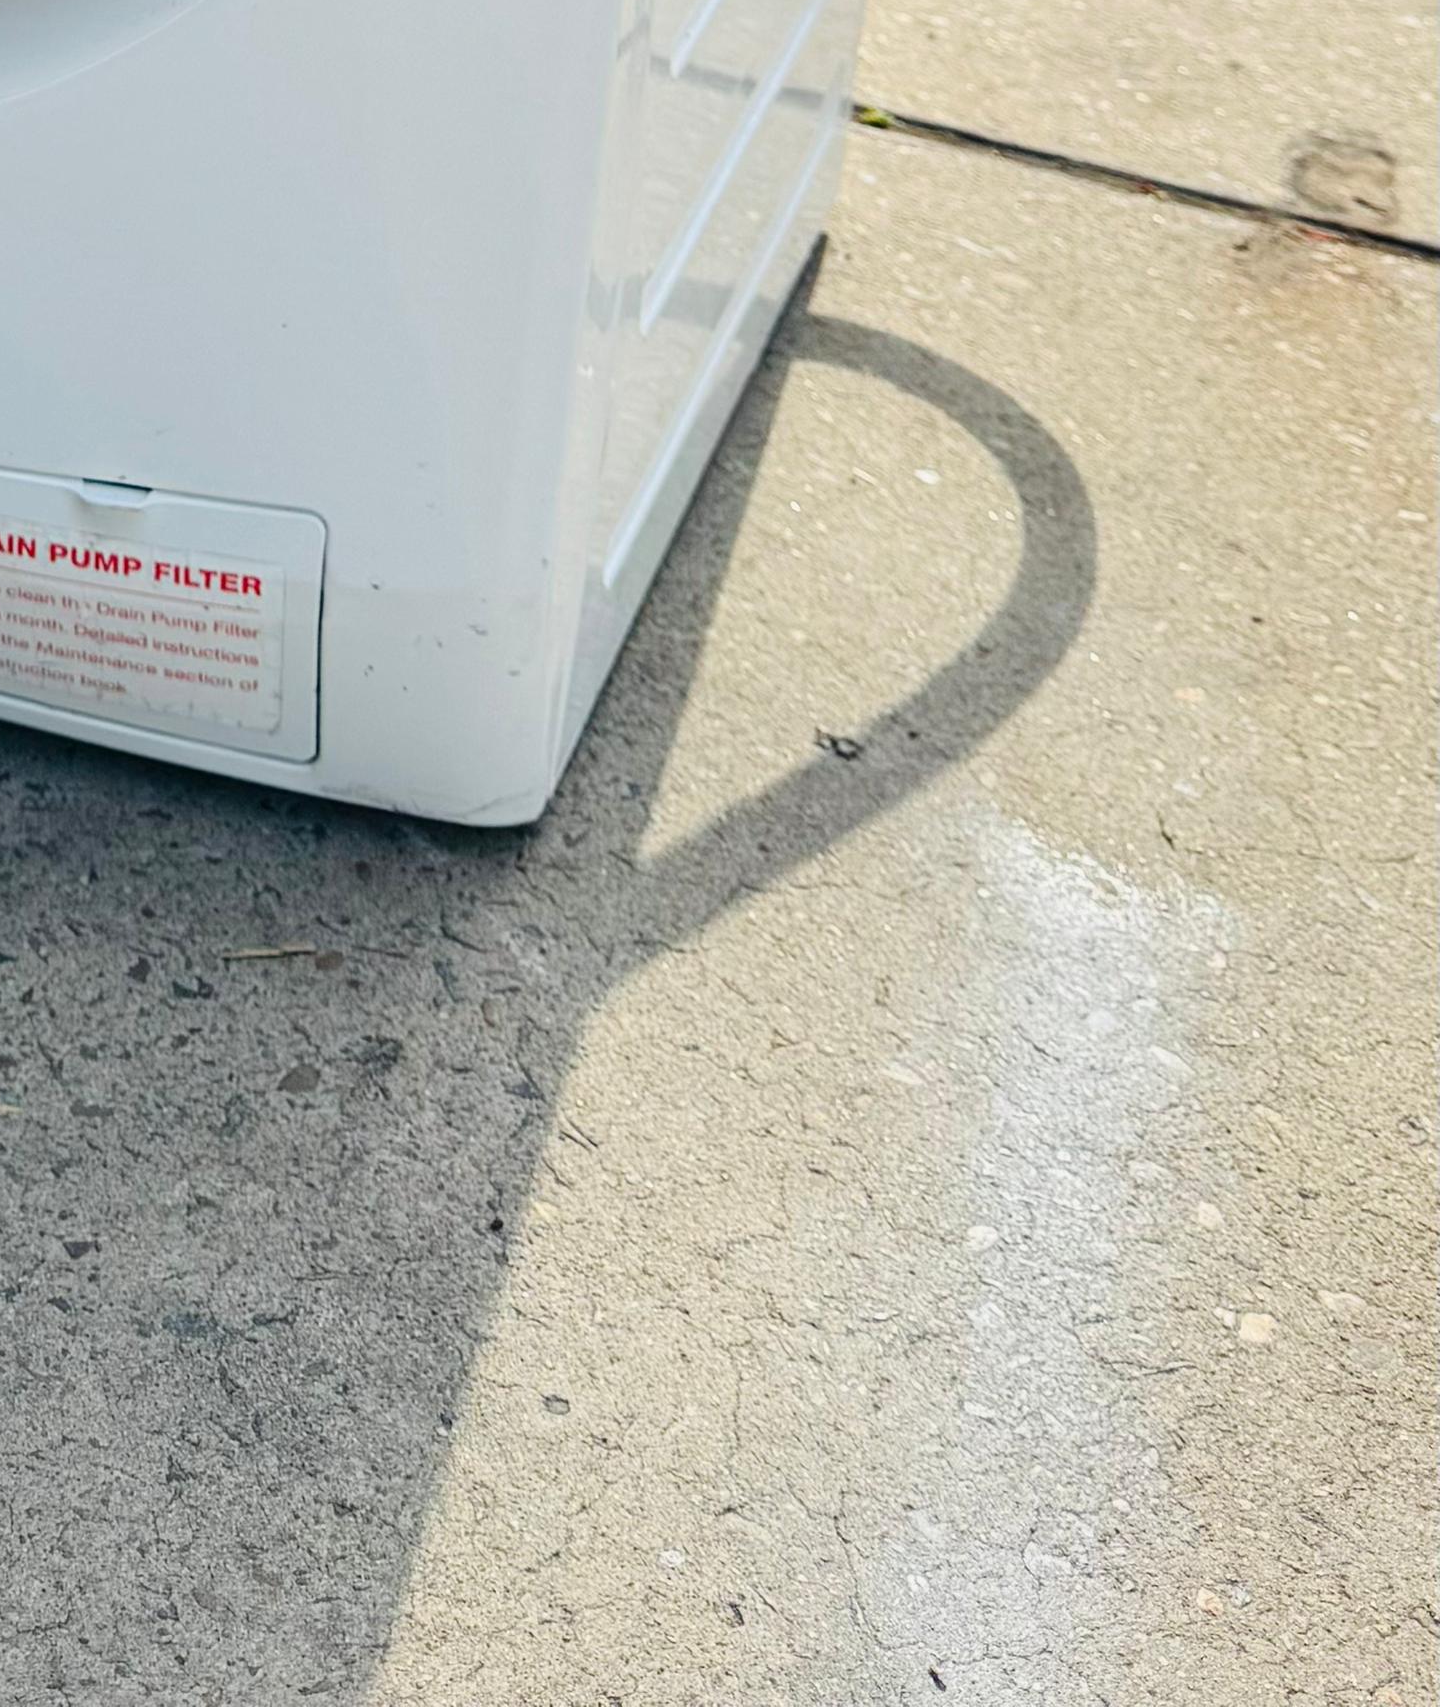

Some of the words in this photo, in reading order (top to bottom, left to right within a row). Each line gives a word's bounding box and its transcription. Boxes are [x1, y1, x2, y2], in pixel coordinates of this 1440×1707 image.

[49, 543, 142, 576] PUMP
[154, 561, 262, 597] FILTER
[6, 587, 56, 606] clean
[96, 601, 145, 622] Drain
[151, 610, 207, 633] Pump
[213, 620, 260, 639] Filter
[1, 634, 29, 650] the
[36, 641, 157, 675] Maintenance
[164, 667, 233, 689] section
[239, 679, 258, 692] of
[74, 623, 148, 649] Detailed
[152, 639, 259, 667] instructions
